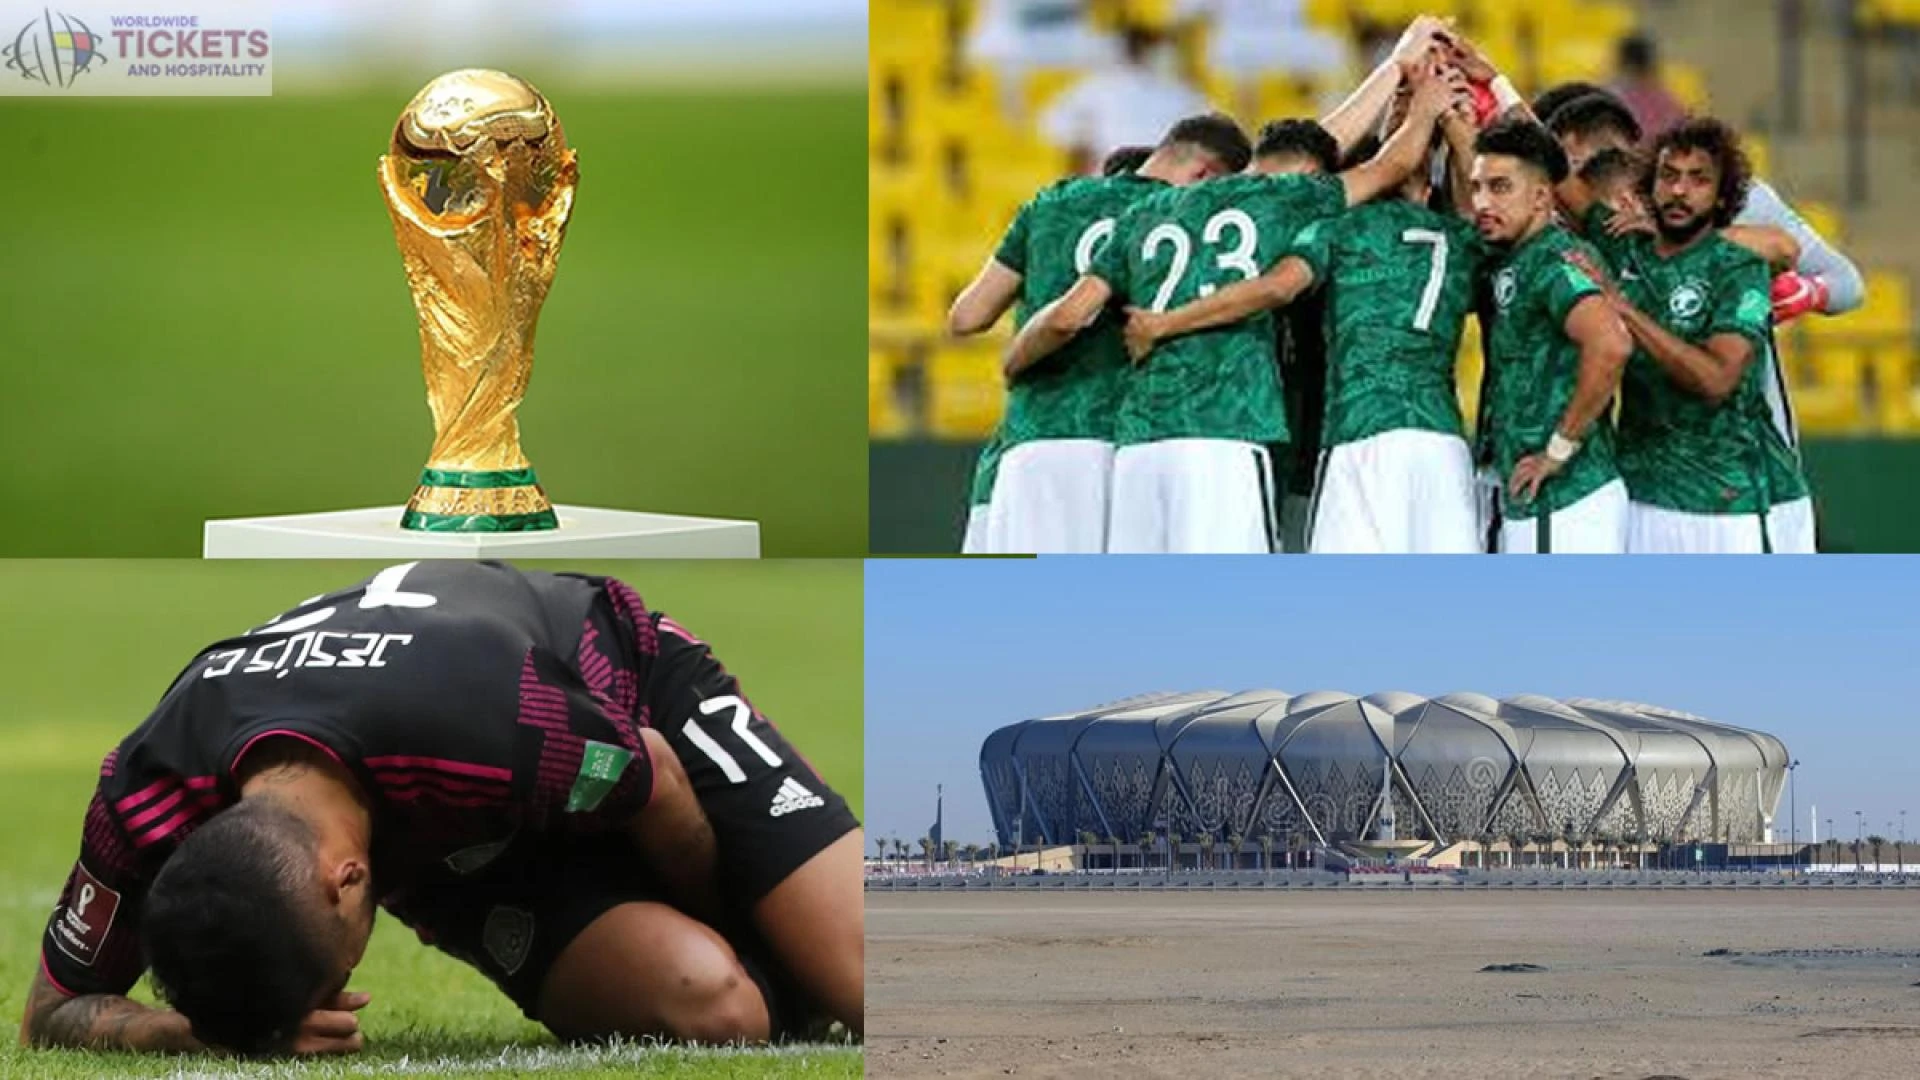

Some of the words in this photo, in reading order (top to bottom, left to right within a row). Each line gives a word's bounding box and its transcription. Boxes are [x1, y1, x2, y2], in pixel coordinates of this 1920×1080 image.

[1142, 208, 1260, 314] 23
[1403, 228, 1448, 331] 7
[682, 695, 783, 784] 17
[769, 795, 825, 817] adidas
